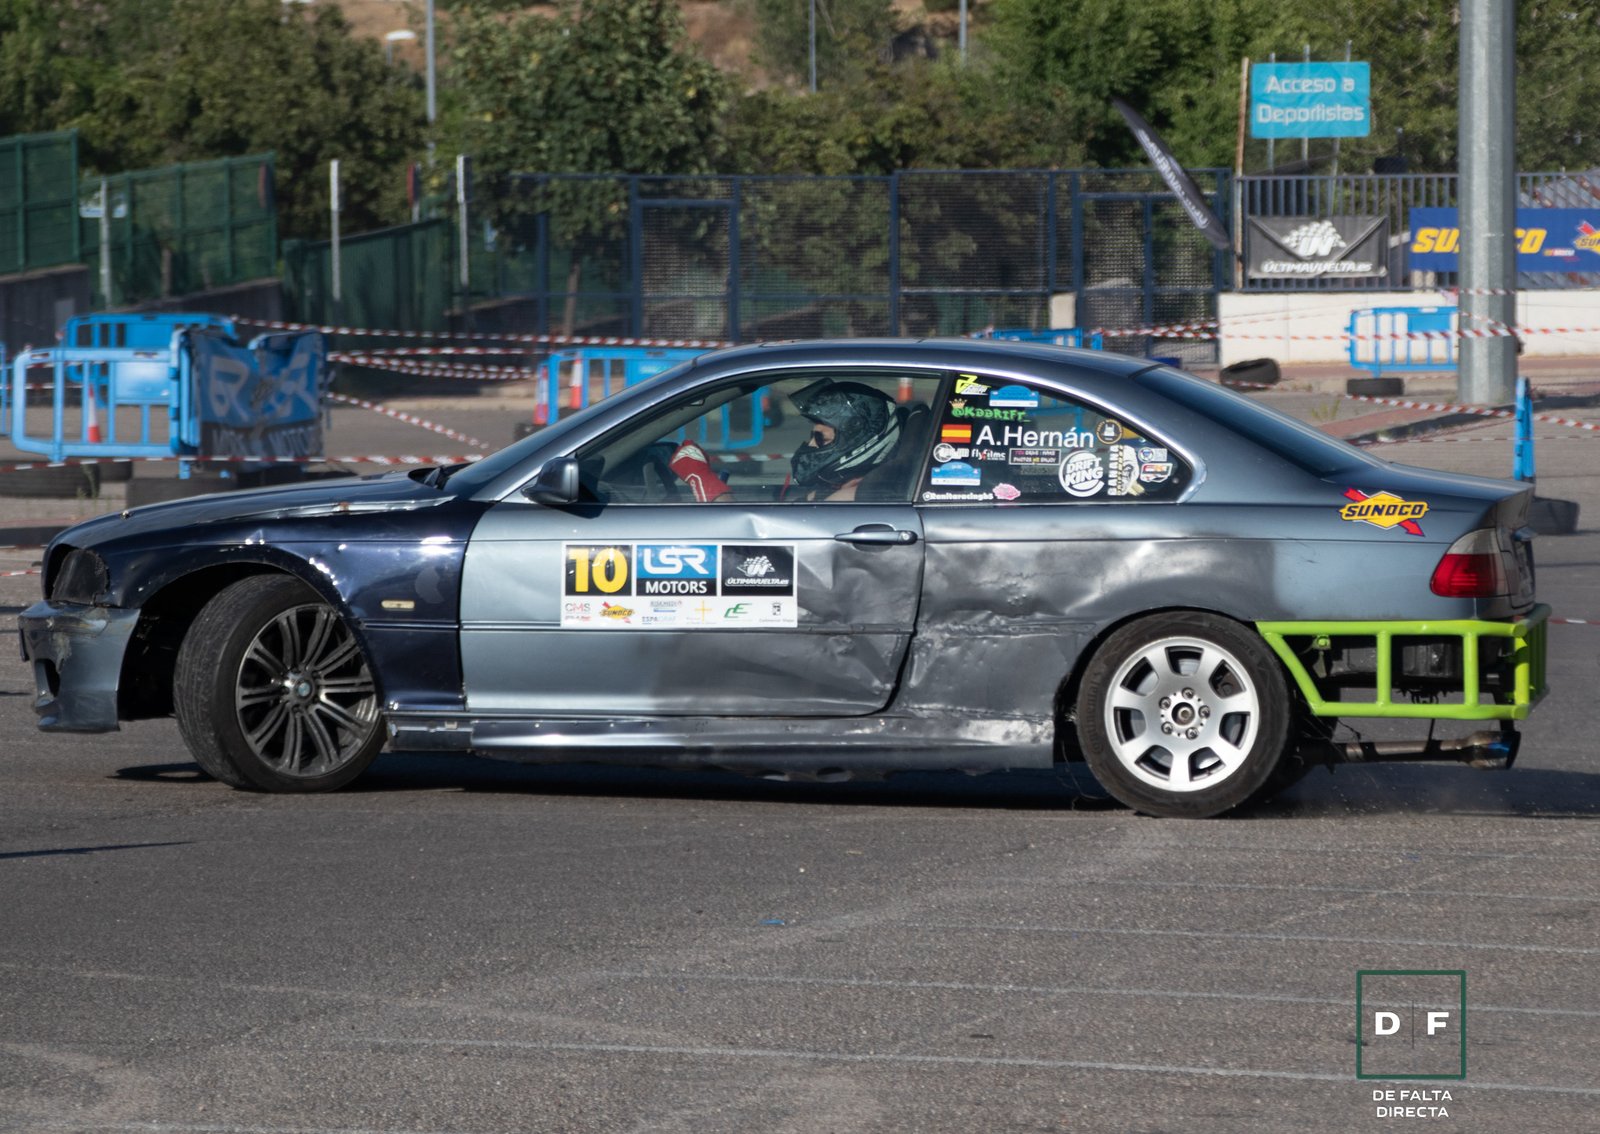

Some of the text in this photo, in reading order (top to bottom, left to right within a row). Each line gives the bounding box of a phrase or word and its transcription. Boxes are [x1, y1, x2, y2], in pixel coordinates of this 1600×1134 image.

[1264, 76, 1355, 94] Acceso a
[1257, 104, 1365, 126] Deportistas
[975, 425, 1095, 449] A.Hernán
[1066, 457, 1102, 475] DRIFT
[1107, 445, 1119, 496] BANANA
[1064, 466, 1104, 486] KING
[1345, 504, 1425, 517] SUNOCO
[567, 548, 629, 594] 10
[643, 548, 710, 575] LSR
[645, 581, 708, 594] MOTORS
[565, 603, 591, 612] CMS
[601, 609, 634, 617] SUNOCO
